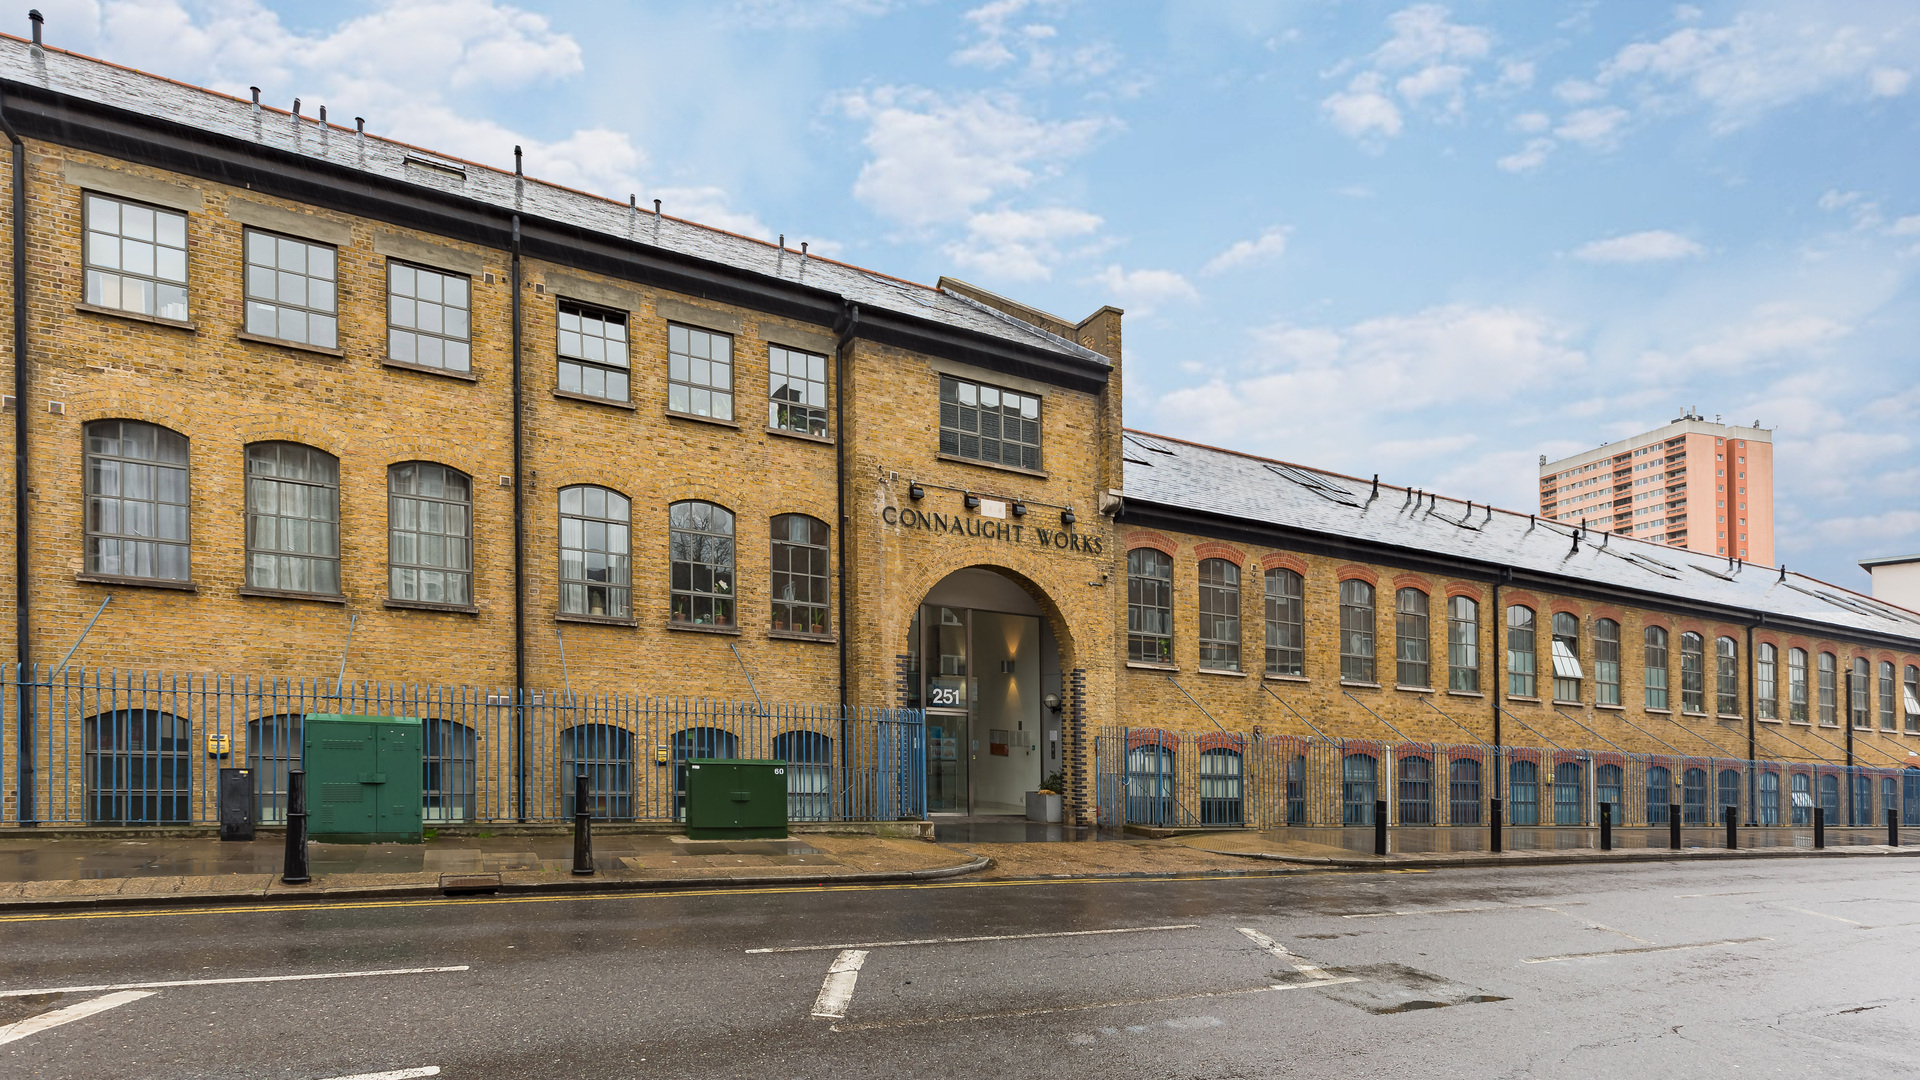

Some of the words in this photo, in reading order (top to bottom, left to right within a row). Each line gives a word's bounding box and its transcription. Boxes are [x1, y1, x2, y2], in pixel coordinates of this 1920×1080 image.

[882, 505, 1024, 542] CONNAUGHT
[1036, 528, 1103, 554] WORKS
[932, 688, 960, 705] 251
